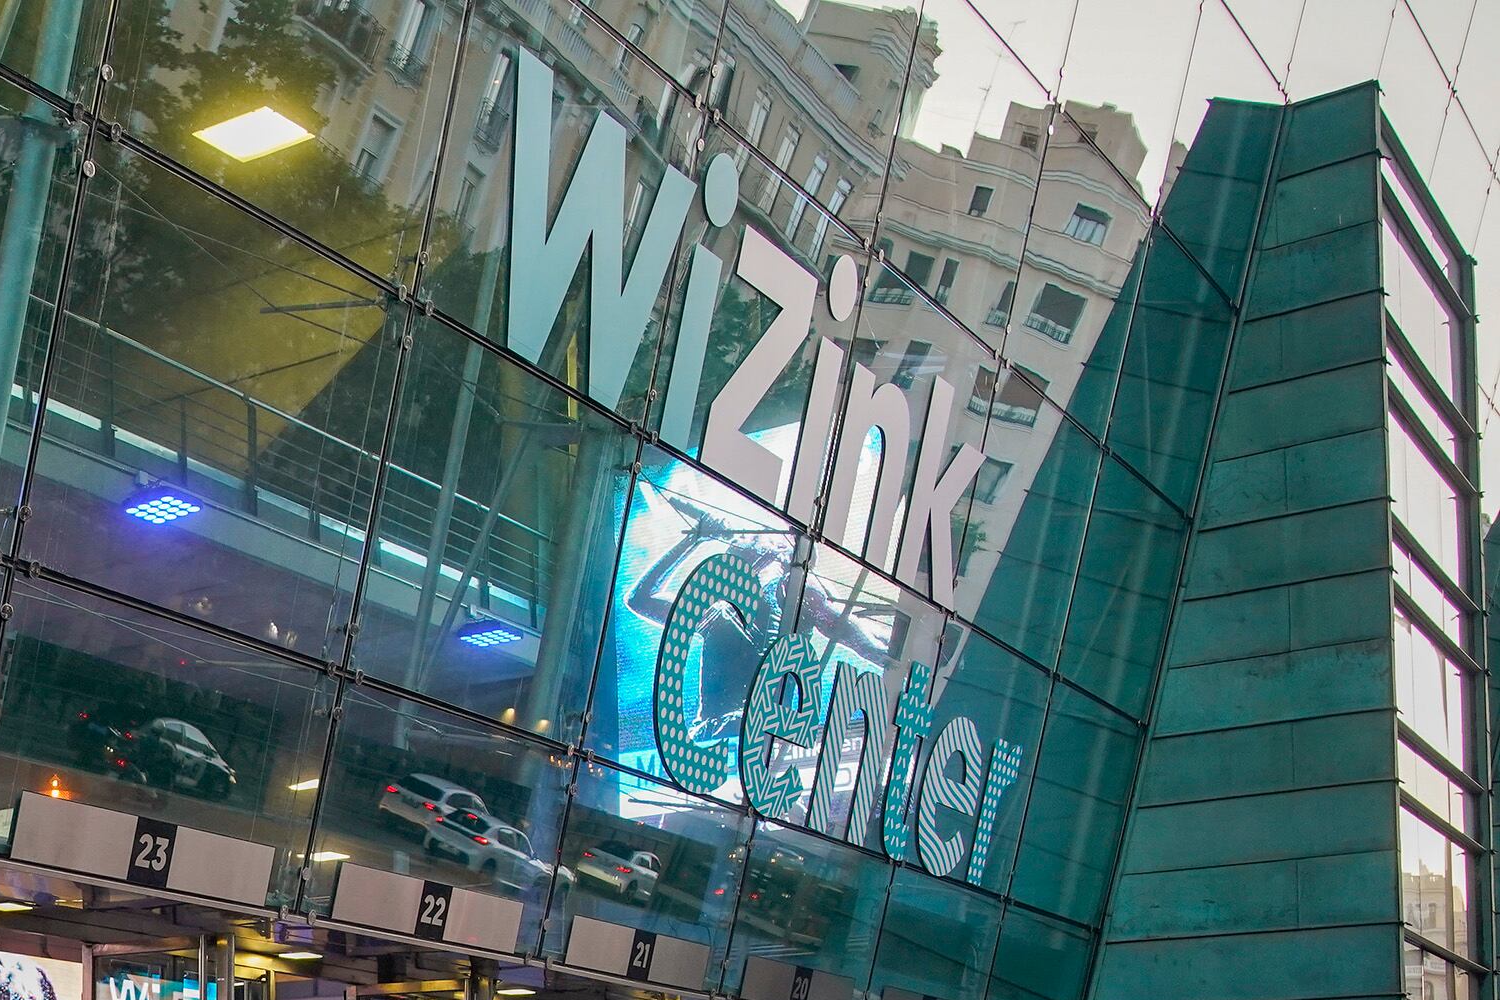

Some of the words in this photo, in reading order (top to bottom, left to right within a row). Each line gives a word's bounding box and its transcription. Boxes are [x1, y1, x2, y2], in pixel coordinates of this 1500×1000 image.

[506, 45, 986, 616] WiZink
[652, 552, 1022, 884] Center
[135, 833, 170, 871] 23
[421, 894, 446, 927] 22
[633, 941, 651, 969] 21
[792, 976, 809, 1000] 20
